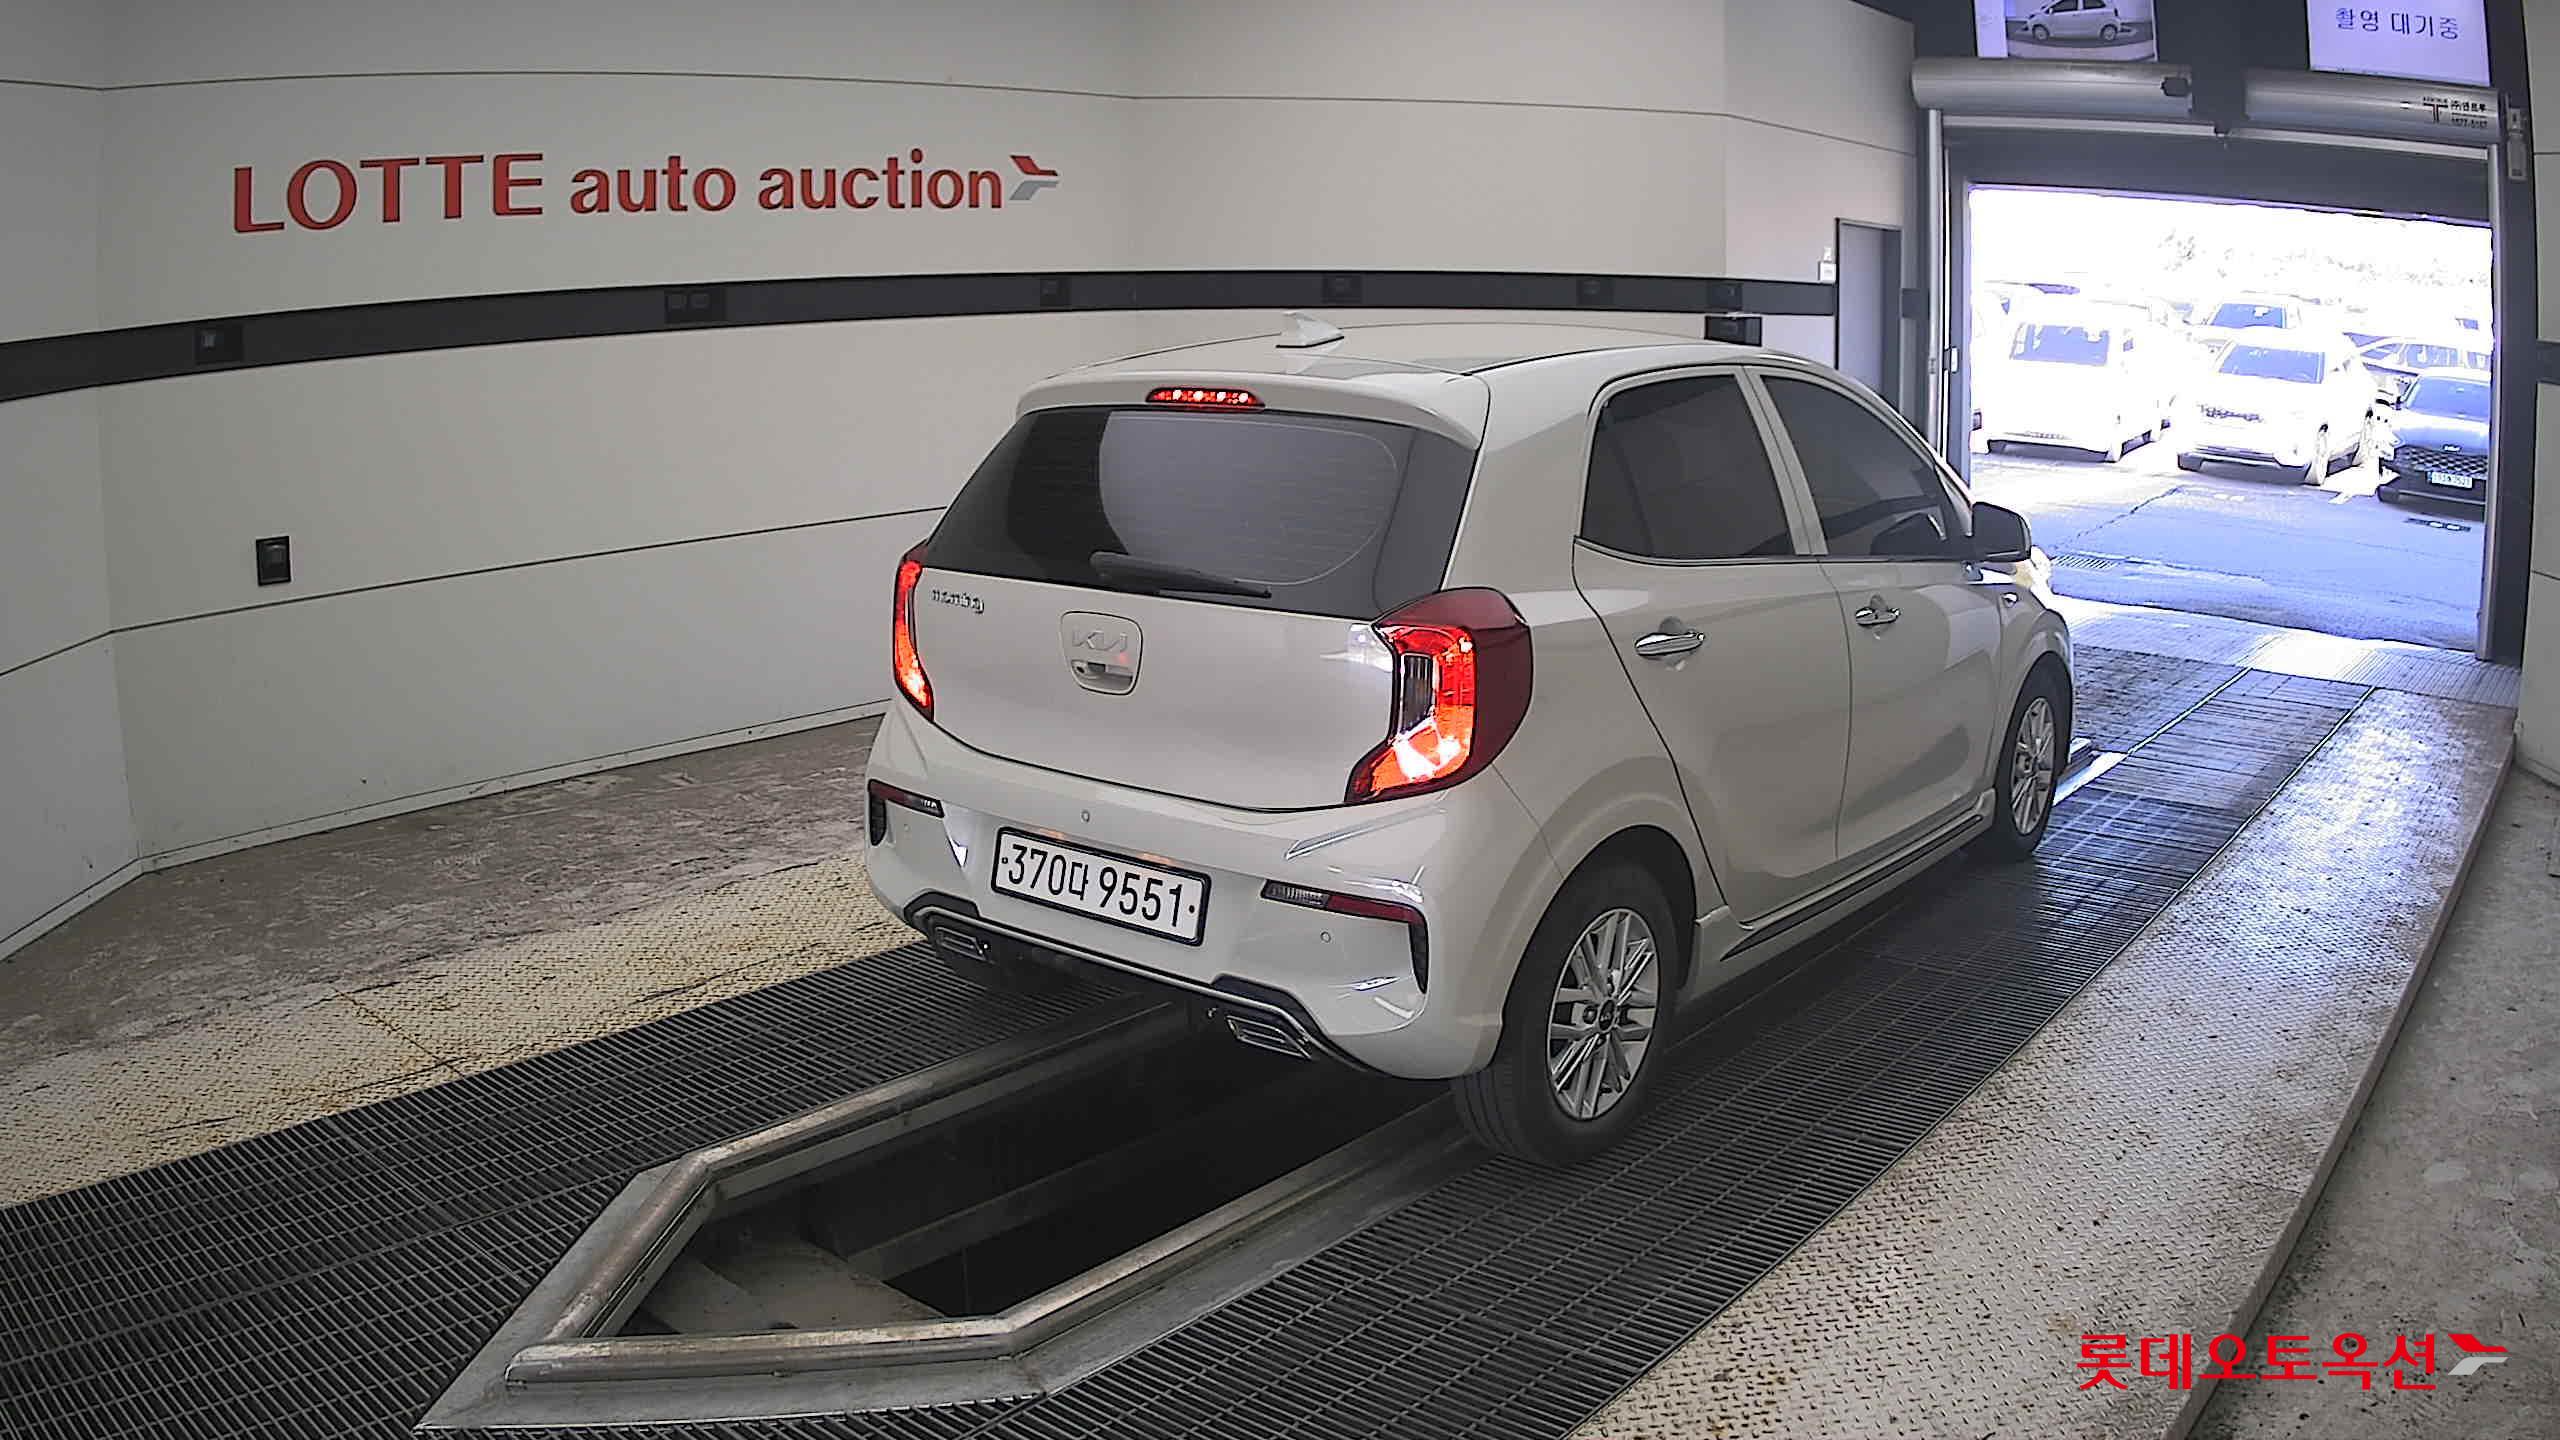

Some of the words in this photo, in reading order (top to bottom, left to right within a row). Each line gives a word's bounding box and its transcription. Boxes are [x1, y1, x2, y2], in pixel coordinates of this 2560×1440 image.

[2336, 7, 2379, 32] 촬영
[2391, 12, 2459, 40] 대기중
[235, 153, 543, 233] LOTTE
[570, 155, 736, 214] auto
[758, 148, 1002, 210] auction
[1008, 843, 1089, 901] 370다
[1099, 866, 1183, 928] 9551
